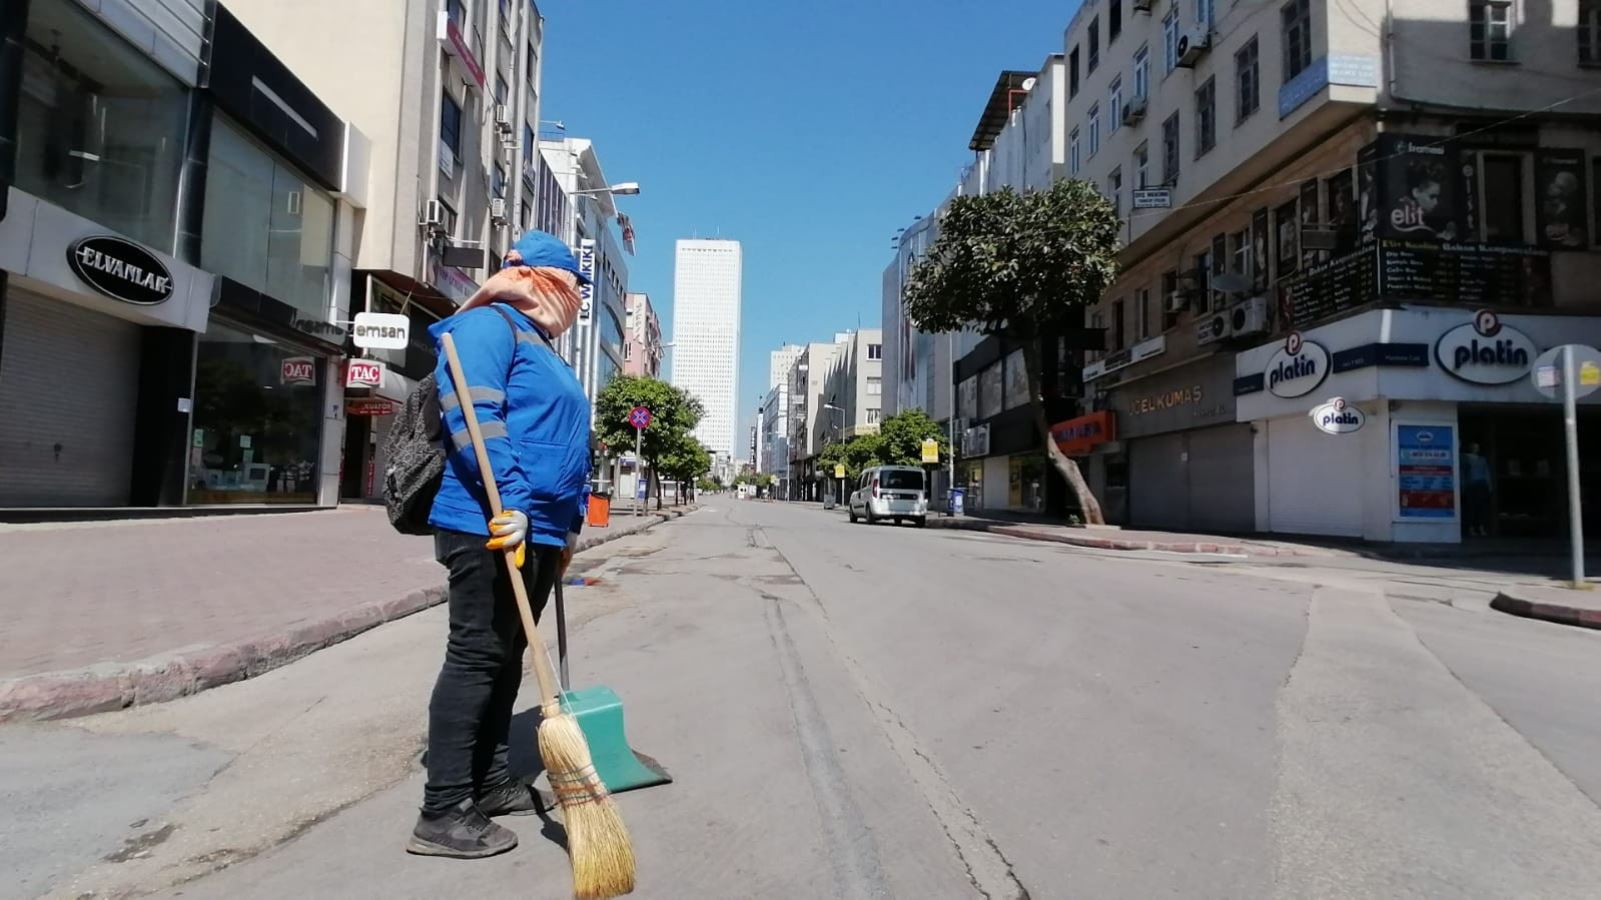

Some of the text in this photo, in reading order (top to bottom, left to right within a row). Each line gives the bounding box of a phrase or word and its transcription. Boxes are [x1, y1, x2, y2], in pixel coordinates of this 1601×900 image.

[1391, 205, 1425, 226] elit
[80, 246, 172, 294] ELVANLAR
[580, 302, 590, 319] LC
[356, 325, 406, 339] emsan
[1454, 338, 1528, 369] platin
[1269, 354, 1316, 389] platin
[1323, 411, 1359, 426] platin
